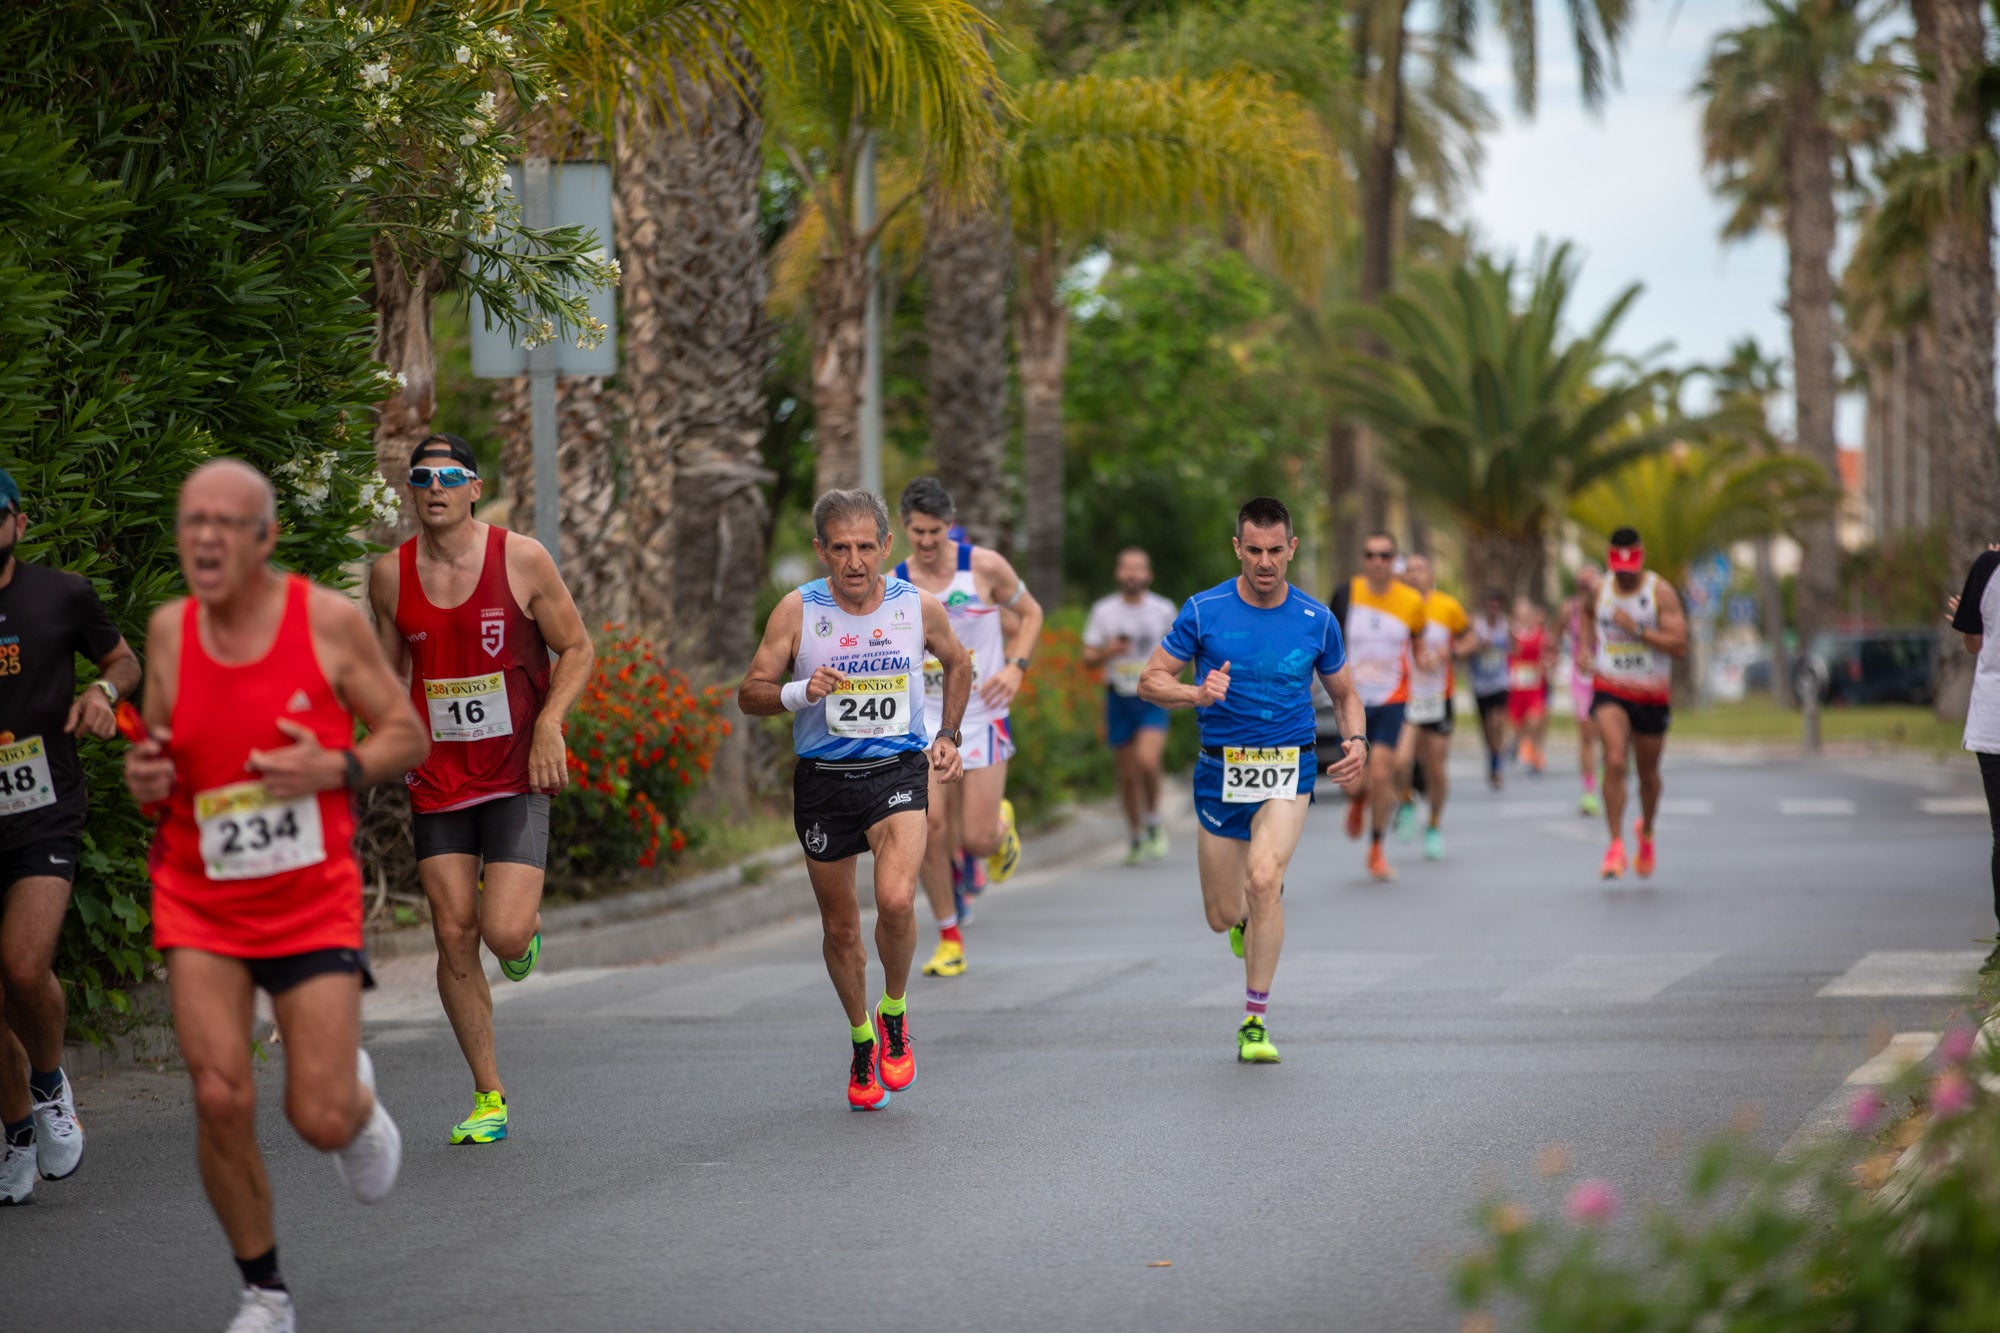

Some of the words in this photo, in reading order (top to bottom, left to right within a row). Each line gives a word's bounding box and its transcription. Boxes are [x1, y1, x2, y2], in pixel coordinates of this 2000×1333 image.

[432, 683, 446, 695] 38
[851, 682, 893, 692] FONDO
[448, 700, 485, 725] 16
[839, 697, 897, 722] 240
[1227, 767, 1296, 789] 3207
[218, 808, 300, 855] 234
